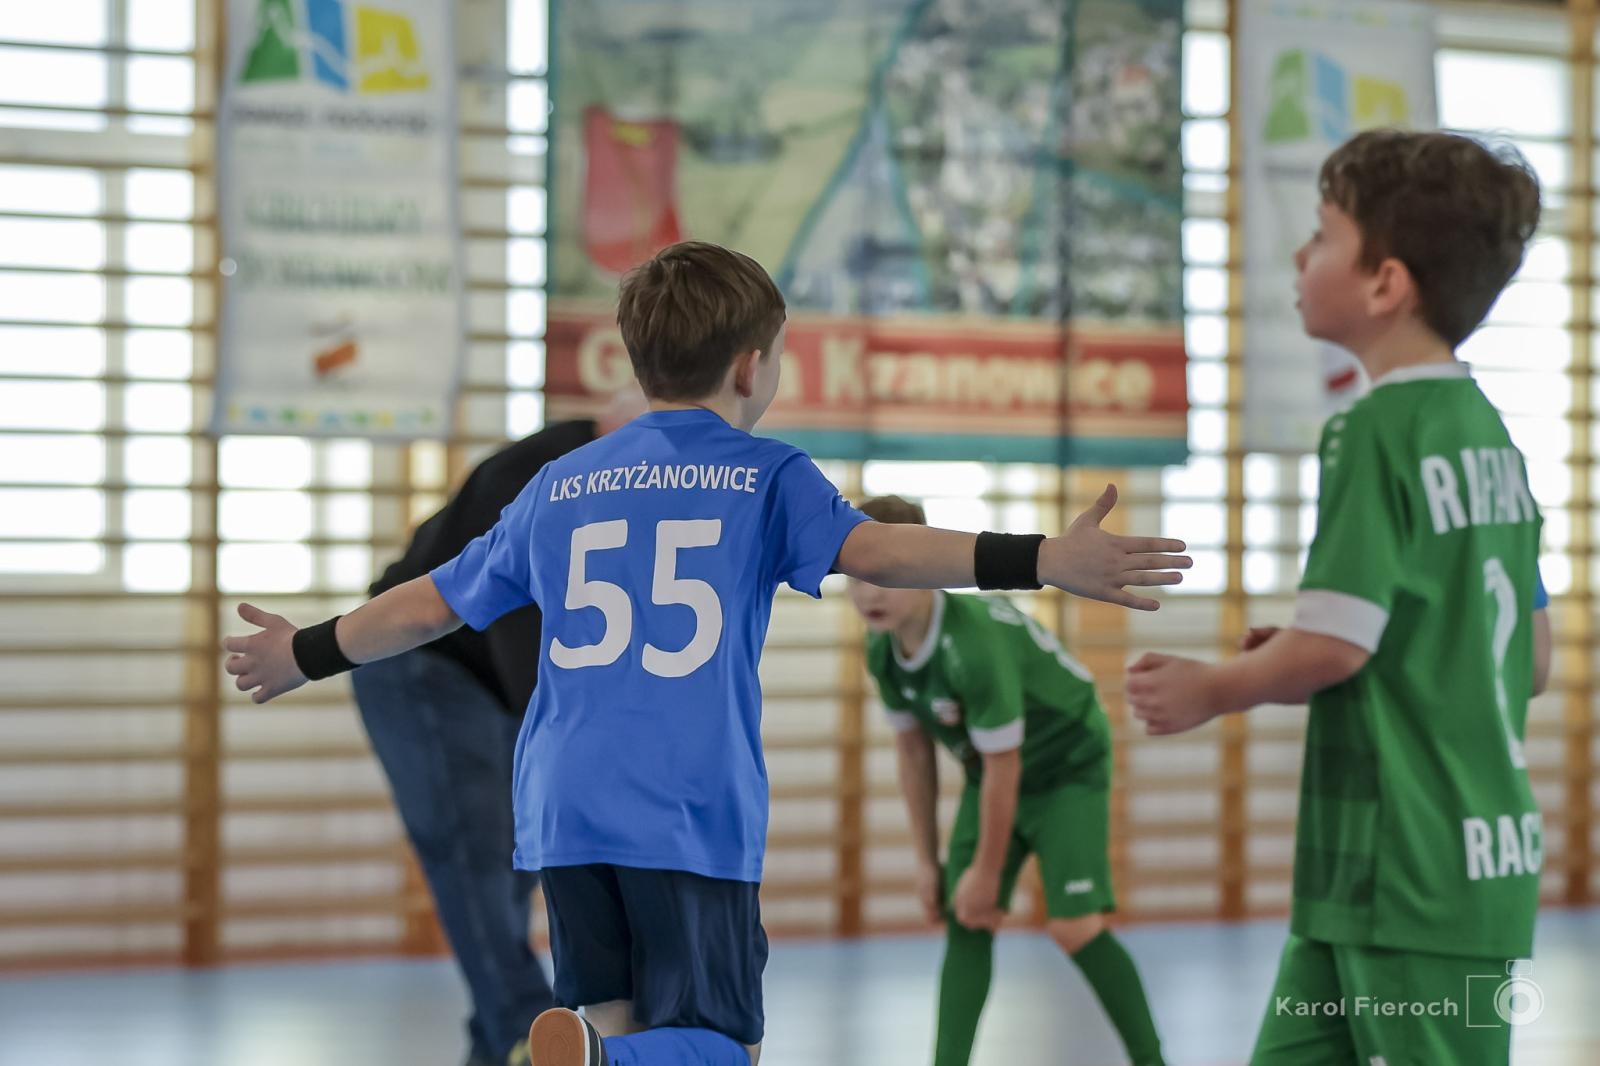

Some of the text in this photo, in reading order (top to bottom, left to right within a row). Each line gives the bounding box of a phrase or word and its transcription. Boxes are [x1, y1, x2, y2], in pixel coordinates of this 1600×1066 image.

[549, 460, 759, 503] LKS KRZYŻANOWICE
[549, 518, 723, 678] 55
